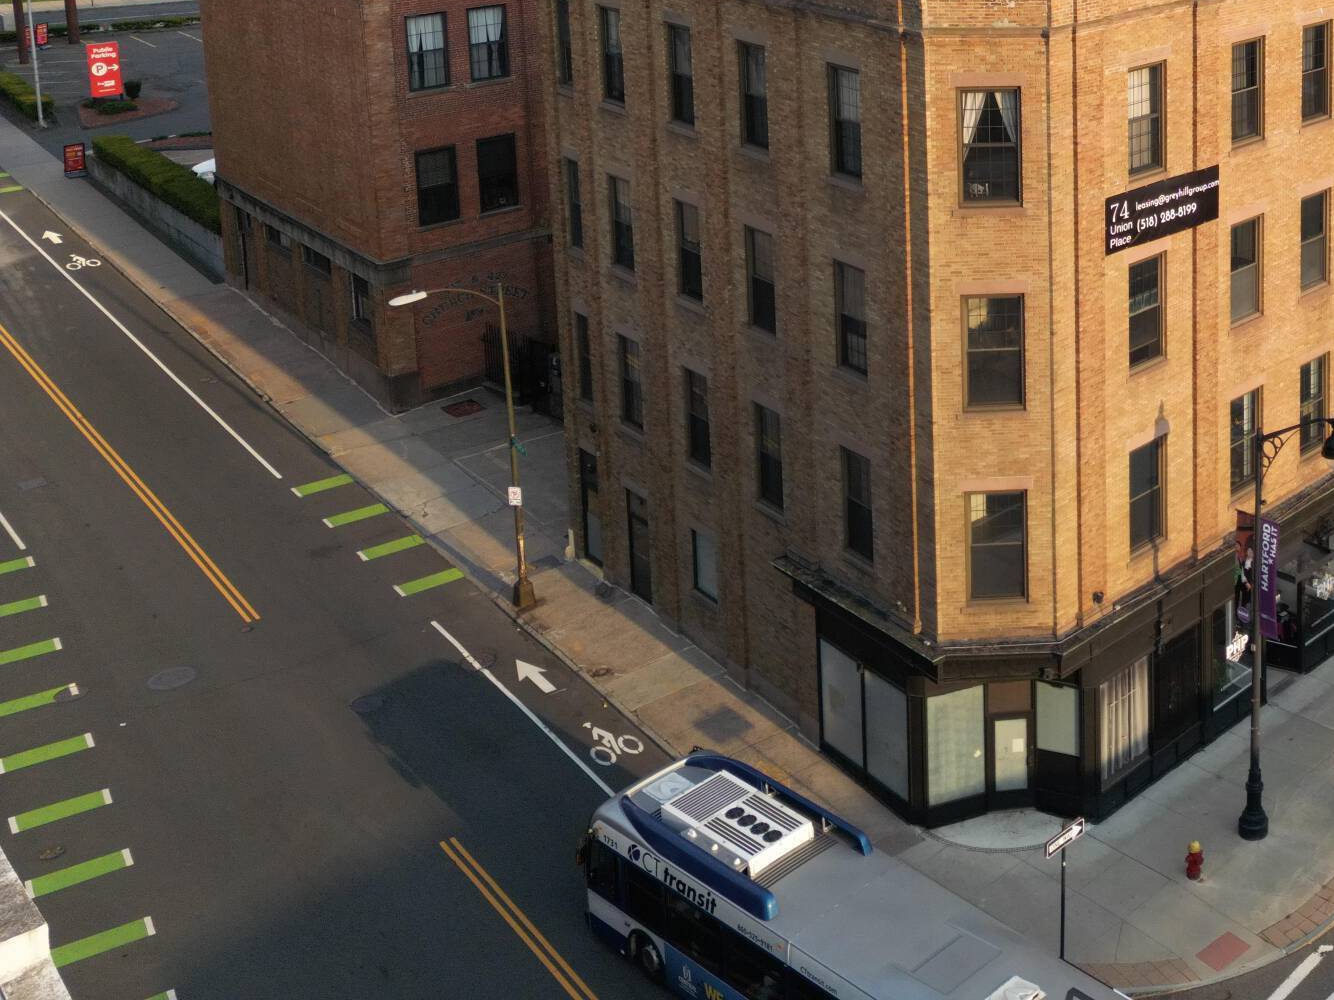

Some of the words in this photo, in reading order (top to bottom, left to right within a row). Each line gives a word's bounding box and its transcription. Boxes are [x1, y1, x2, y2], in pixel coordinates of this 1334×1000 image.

[1135, 179, 1220, 211] leasing@greyhillgroup.com
[1110, 200, 1130, 223] 74
[1137, 213, 1158, 232] (518)
[1160, 202, 1197, 223] 288-8199
[1110, 221, 1133, 235] Union
[1110, 235, 1132, 249] Place
[1261, 523, 1271, 591] HARTFORD
